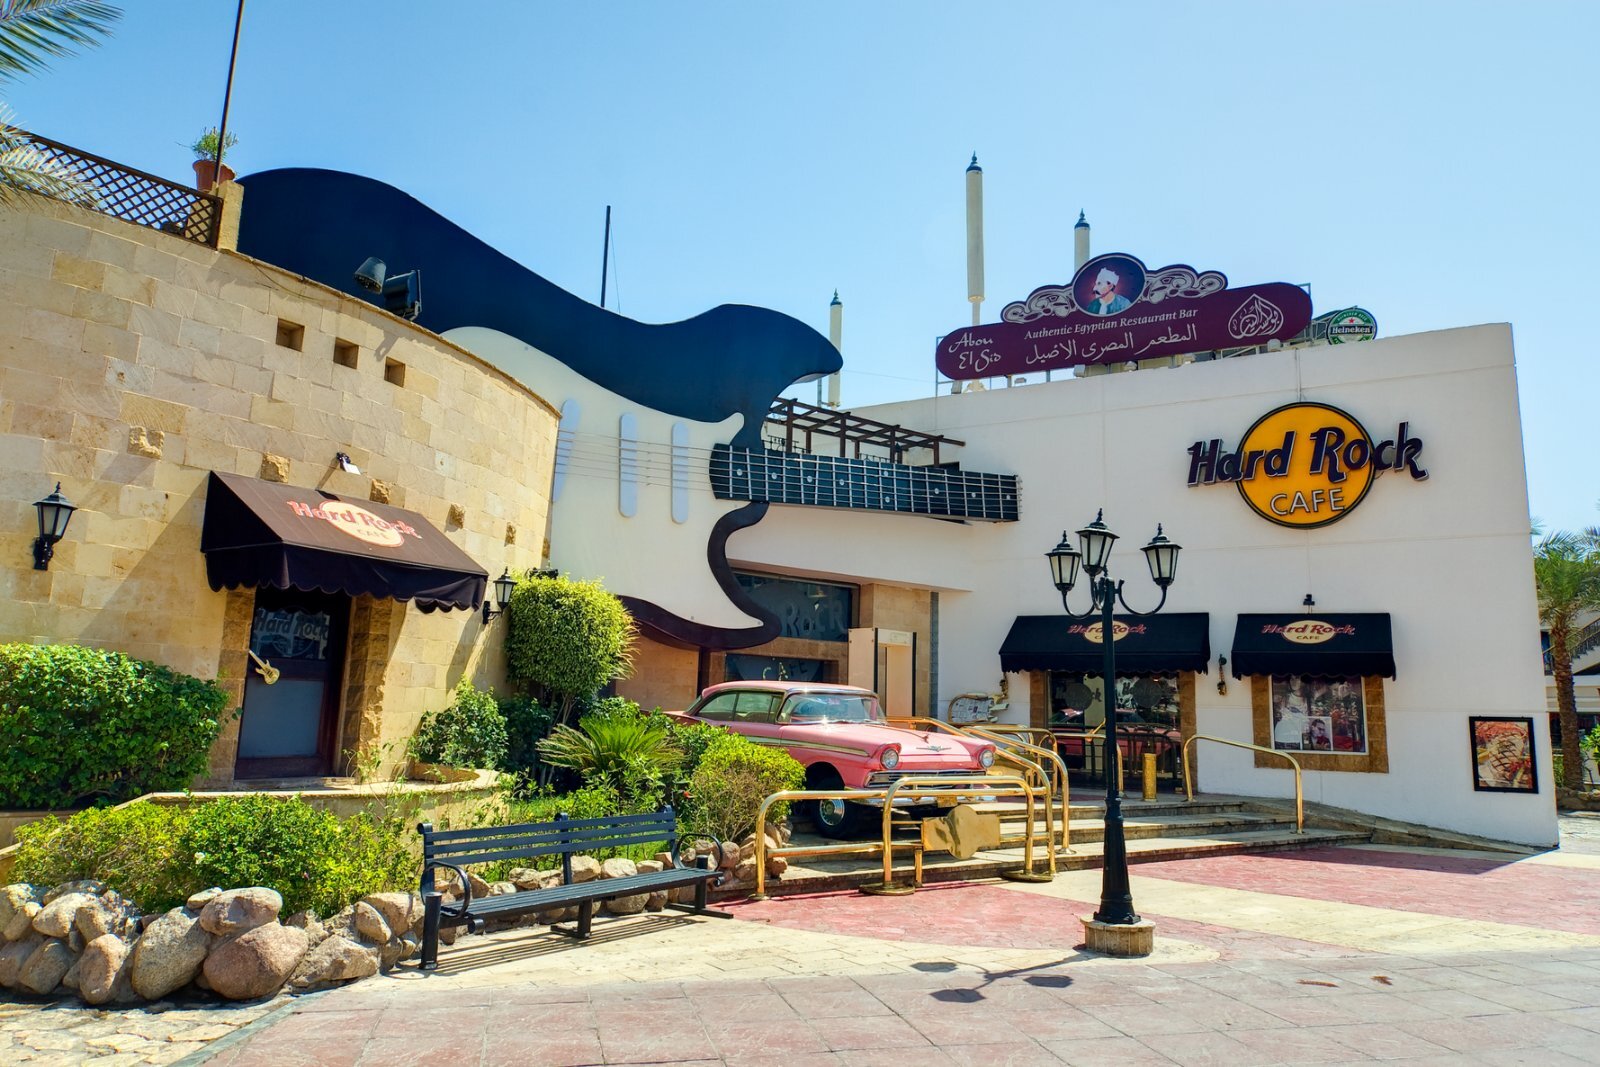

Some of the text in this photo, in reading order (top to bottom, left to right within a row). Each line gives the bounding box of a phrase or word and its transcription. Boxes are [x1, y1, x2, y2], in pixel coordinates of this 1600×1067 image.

[1024, 308, 1198, 340] Authentic Egyptian Restaurant Bar
[1332, 325, 1371, 334] Heineken
[948, 332, 994, 353] Abou
[1134, 323, 1198, 356] المطعم
[959, 348, 1001, 373] El Sid
[1187, 421, 1430, 488] Hard Rock
[1270, 488, 1346, 516] CAFE
[286, 500, 423, 539] Hard Rock
[1261, 624, 1355, 635] Hard Rock
